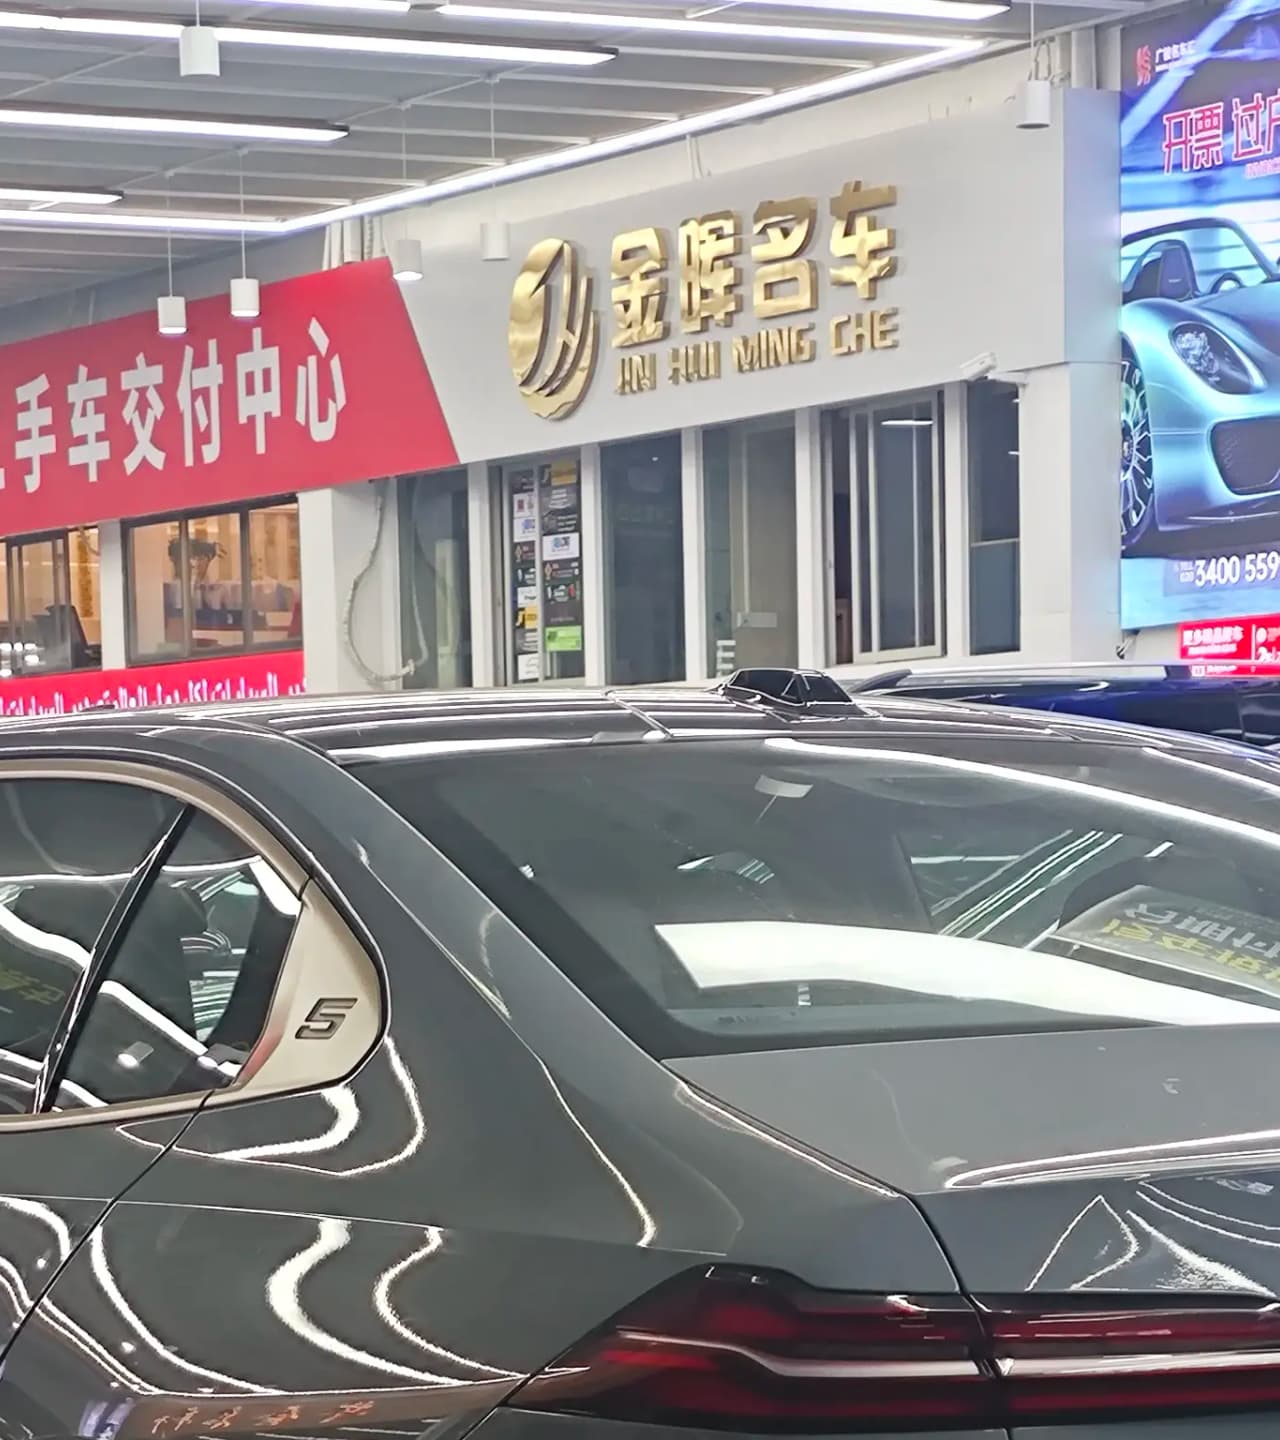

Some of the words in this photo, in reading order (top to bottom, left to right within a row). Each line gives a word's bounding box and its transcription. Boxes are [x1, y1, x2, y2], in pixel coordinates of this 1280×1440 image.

[1161, 101, 1224, 176] 开票
[610, 180, 898, 348] 金晖名车
[615, 353, 656, 395] JIN
[669, 340, 721, 386] HUI
[732, 322, 816, 374] MING
[829, 307, 899, 357] CHE
[1194, 555, 1241, 587] 3400
[295, 997, 358, 1040] 5
